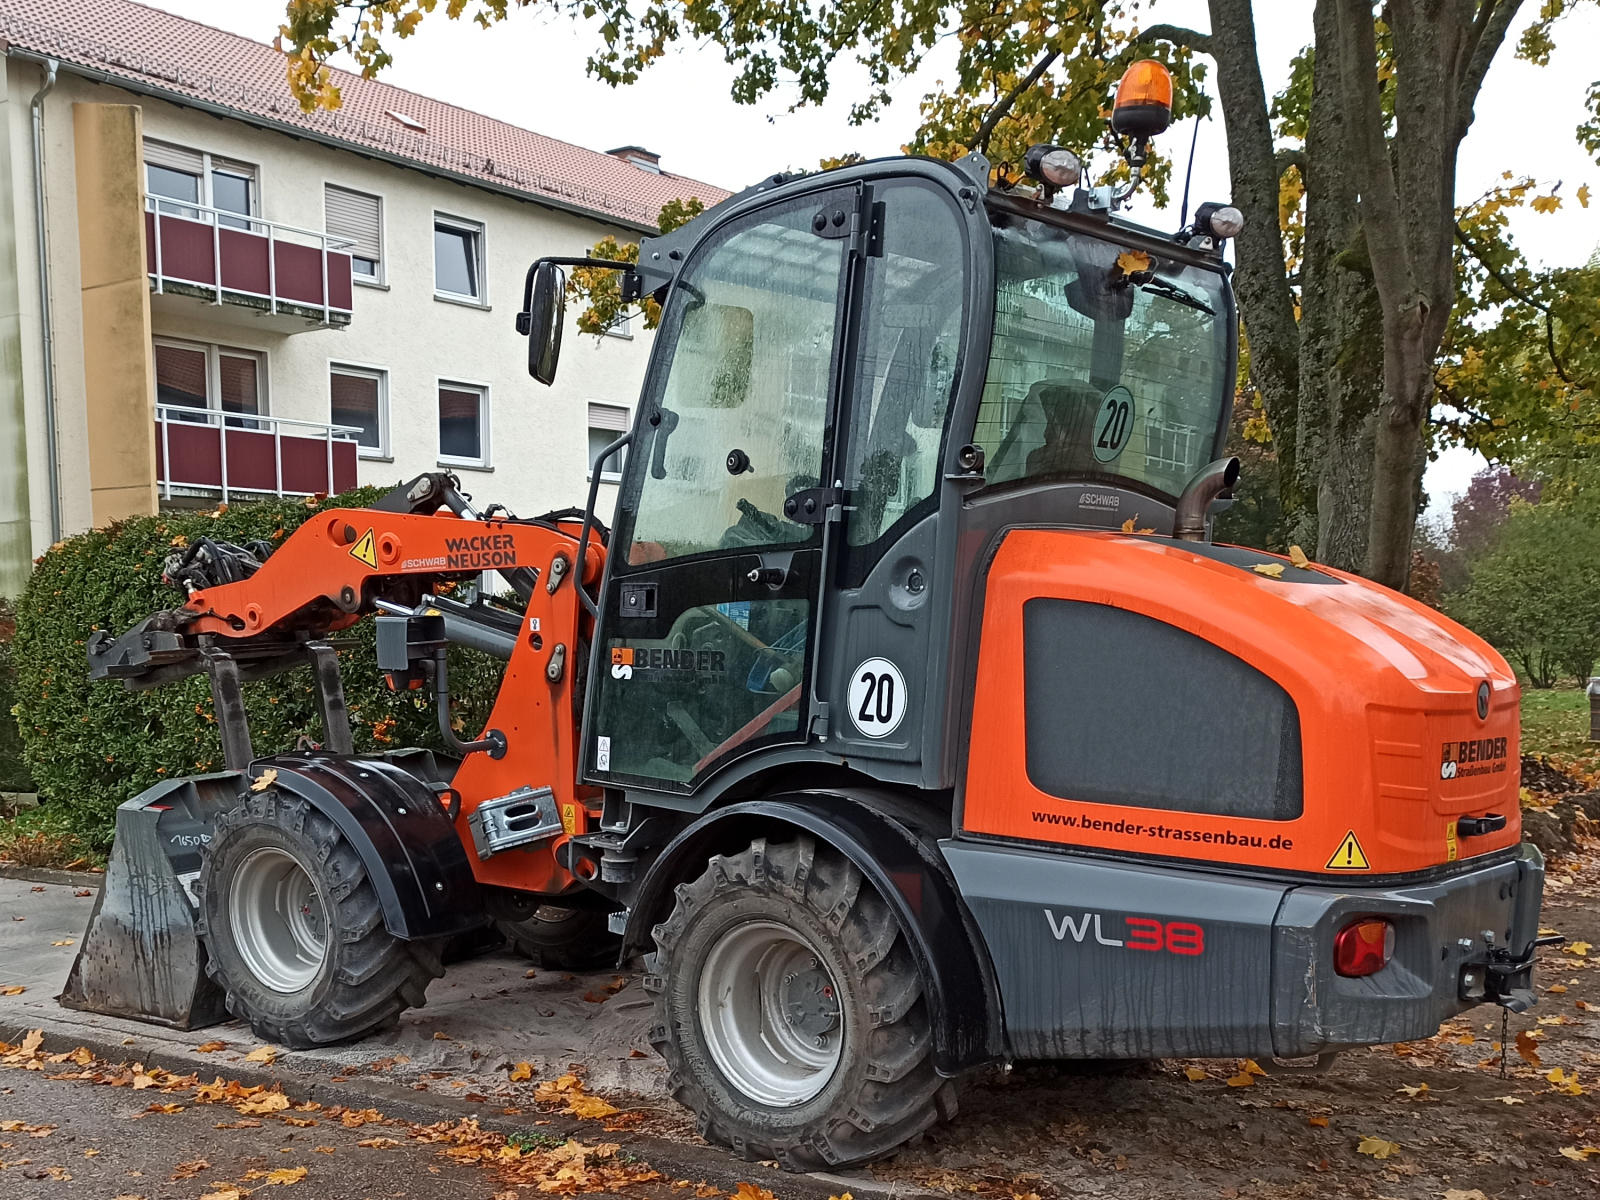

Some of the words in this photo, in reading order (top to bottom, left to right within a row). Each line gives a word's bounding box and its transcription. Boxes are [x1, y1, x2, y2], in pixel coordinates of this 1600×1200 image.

[1097, 399, 1128, 449] 20
[1085, 493, 1119, 506] SCHWAB
[444, 534, 515, 552] WACKER
[407, 557, 446, 567] SCHWAB
[447, 551, 516, 568] NEUSON
[635, 648, 725, 671] BENDER
[858, 671, 894, 723] 20
[1459, 737, 1507, 763] BENDER
[1457, 764, 1490, 777] Straßenbau
[1031, 810, 1294, 851] www.bender-strassenbau.de
[1044, 908, 1204, 956] WL38
